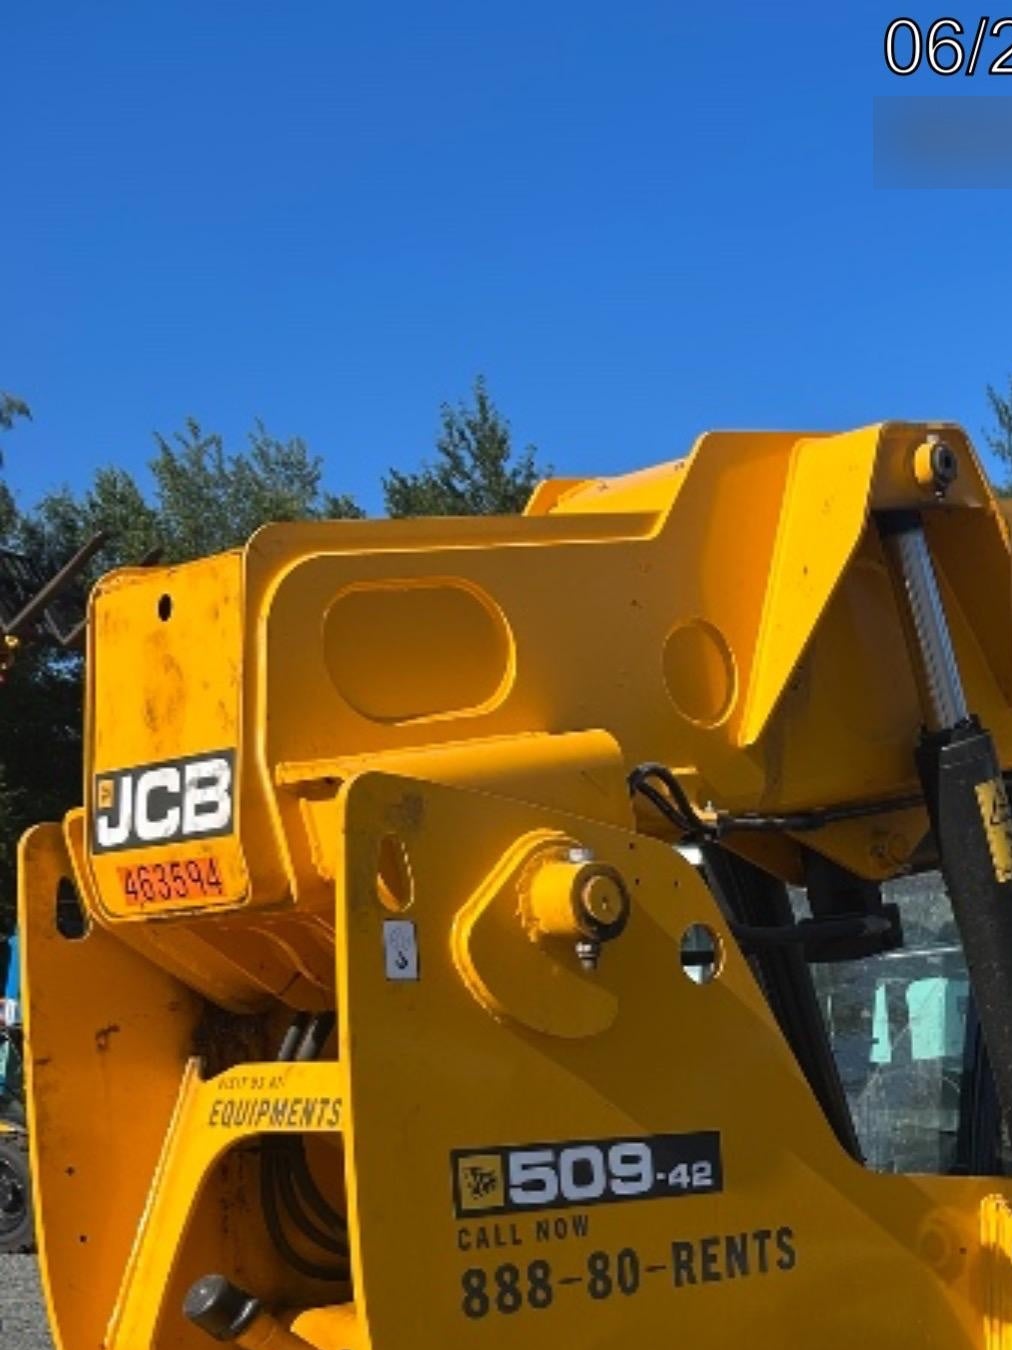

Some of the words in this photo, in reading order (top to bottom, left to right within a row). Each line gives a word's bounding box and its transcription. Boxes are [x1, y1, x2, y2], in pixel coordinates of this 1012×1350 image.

[97, 757, 232, 847] JCB
[124, 857, 223, 901] 463594
[208, 1096, 343, 1128] EQUIPMENTS
[508, 1142, 713, 1205] 509-42
[457, 1222, 523, 1252] CALL
[535, 1214, 590, 1240] NOW
[461, 1226, 797, 1319] 888-80-RENTS
